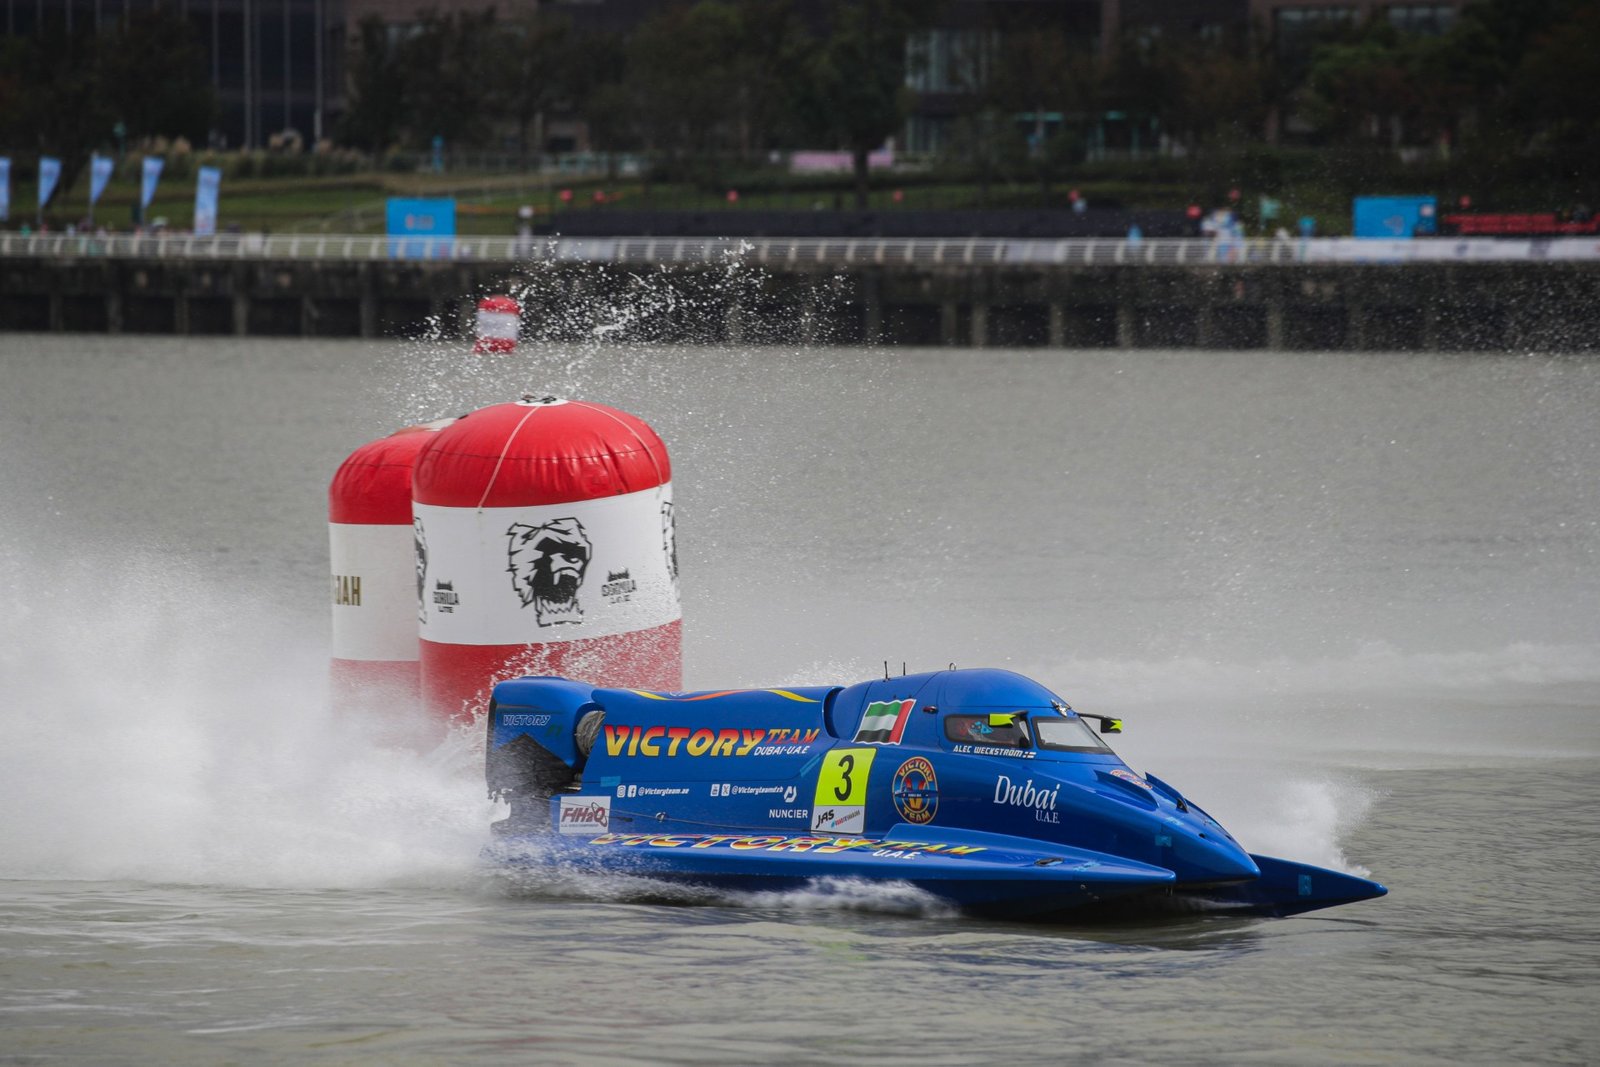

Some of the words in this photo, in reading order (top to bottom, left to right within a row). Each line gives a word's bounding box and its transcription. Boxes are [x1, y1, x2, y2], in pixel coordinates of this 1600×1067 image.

[503, 714, 551, 726] VICTORY
[604, 725, 766, 757] VICTORY
[765, 728, 820, 744] TEAM
[953, 745, 972, 753] ALEC
[834, 754, 855, 802] 3
[898, 759, 934, 782] VICTORY
[993, 775, 1061, 811] Dubai
[768, 809, 809, 819] NUNCIER
[815, 809, 835, 829] JAS
[904, 806, 931, 822] TEAM
[1035, 809, 1061, 824] U.A.E.
[588, 833, 881, 852] VICTORY
[866, 840, 989, 856] TEAM
